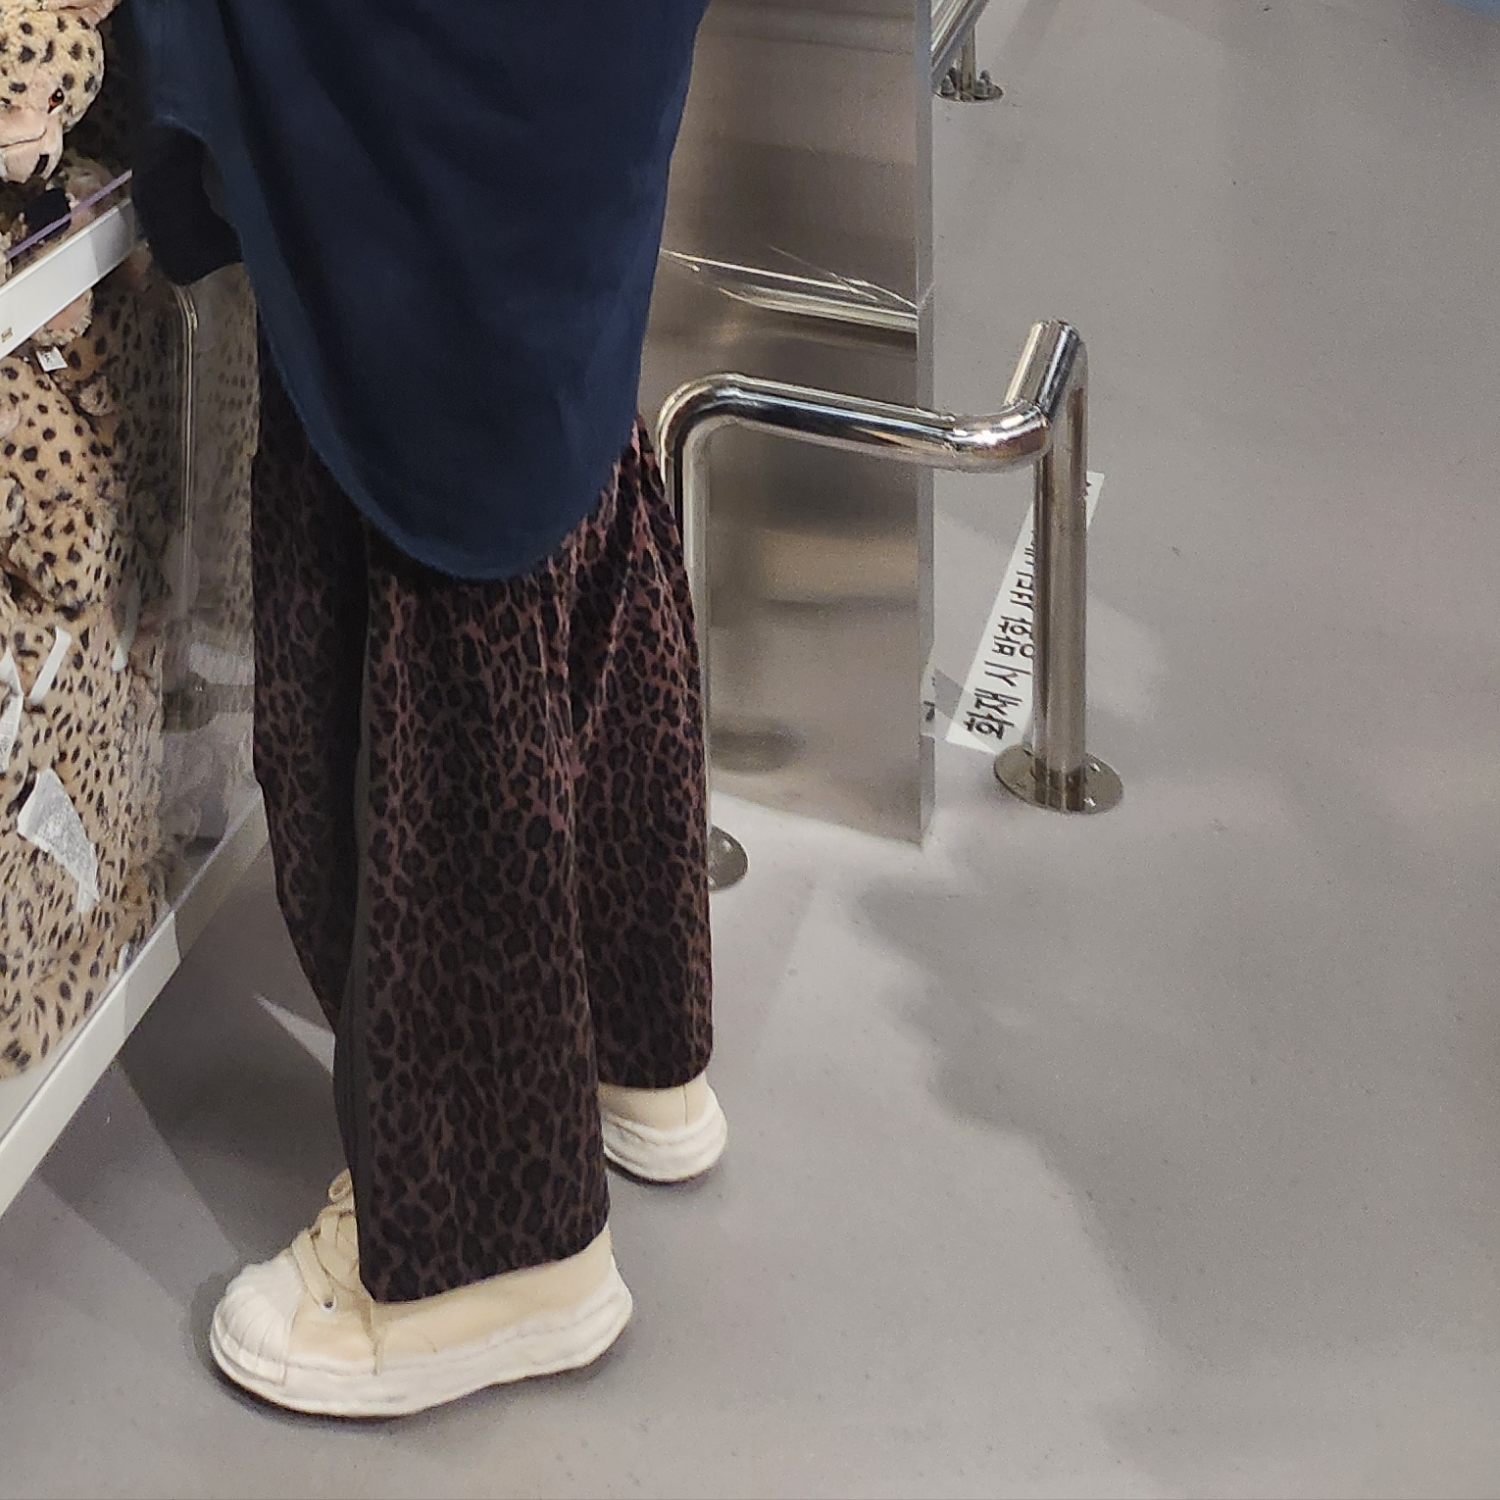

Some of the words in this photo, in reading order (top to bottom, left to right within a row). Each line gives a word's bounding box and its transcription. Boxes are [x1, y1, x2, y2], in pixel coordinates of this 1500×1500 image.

[992, 615, 1034, 658] 방화
[984, 660, 1033, 688] 시
[963, 687, 1023, 741] 화재
